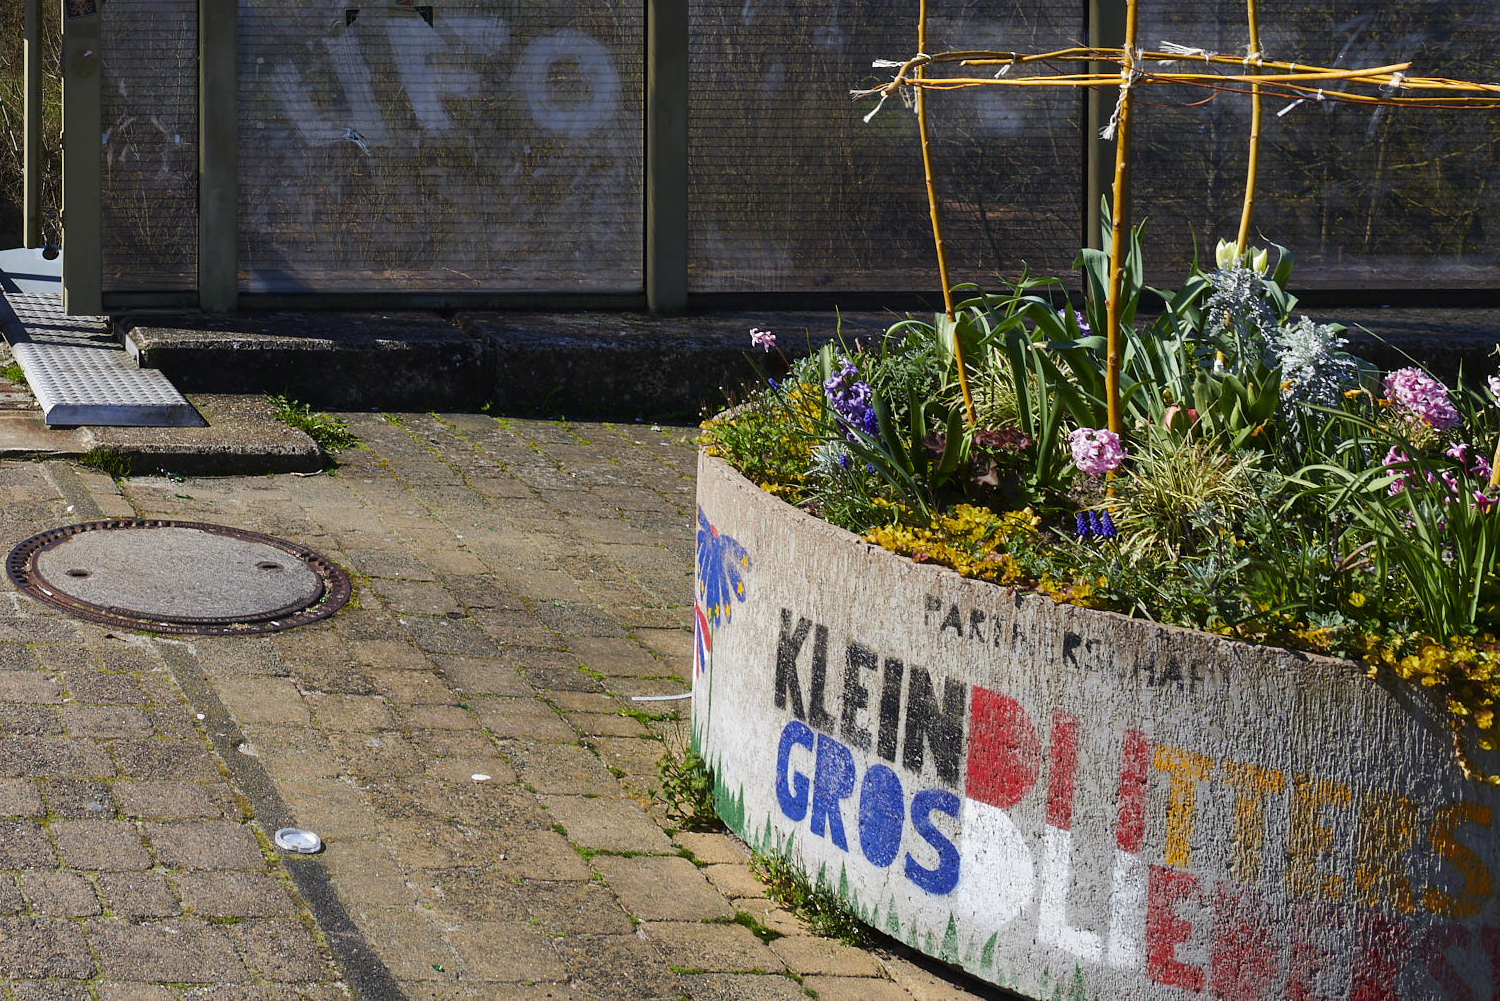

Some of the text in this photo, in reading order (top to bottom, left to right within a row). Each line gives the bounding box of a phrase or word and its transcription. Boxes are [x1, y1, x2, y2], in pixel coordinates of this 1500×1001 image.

[270, 16, 623, 147] UFO
[774, 607, 967, 789] KLEIN
[775, 719, 962, 896] GROS
